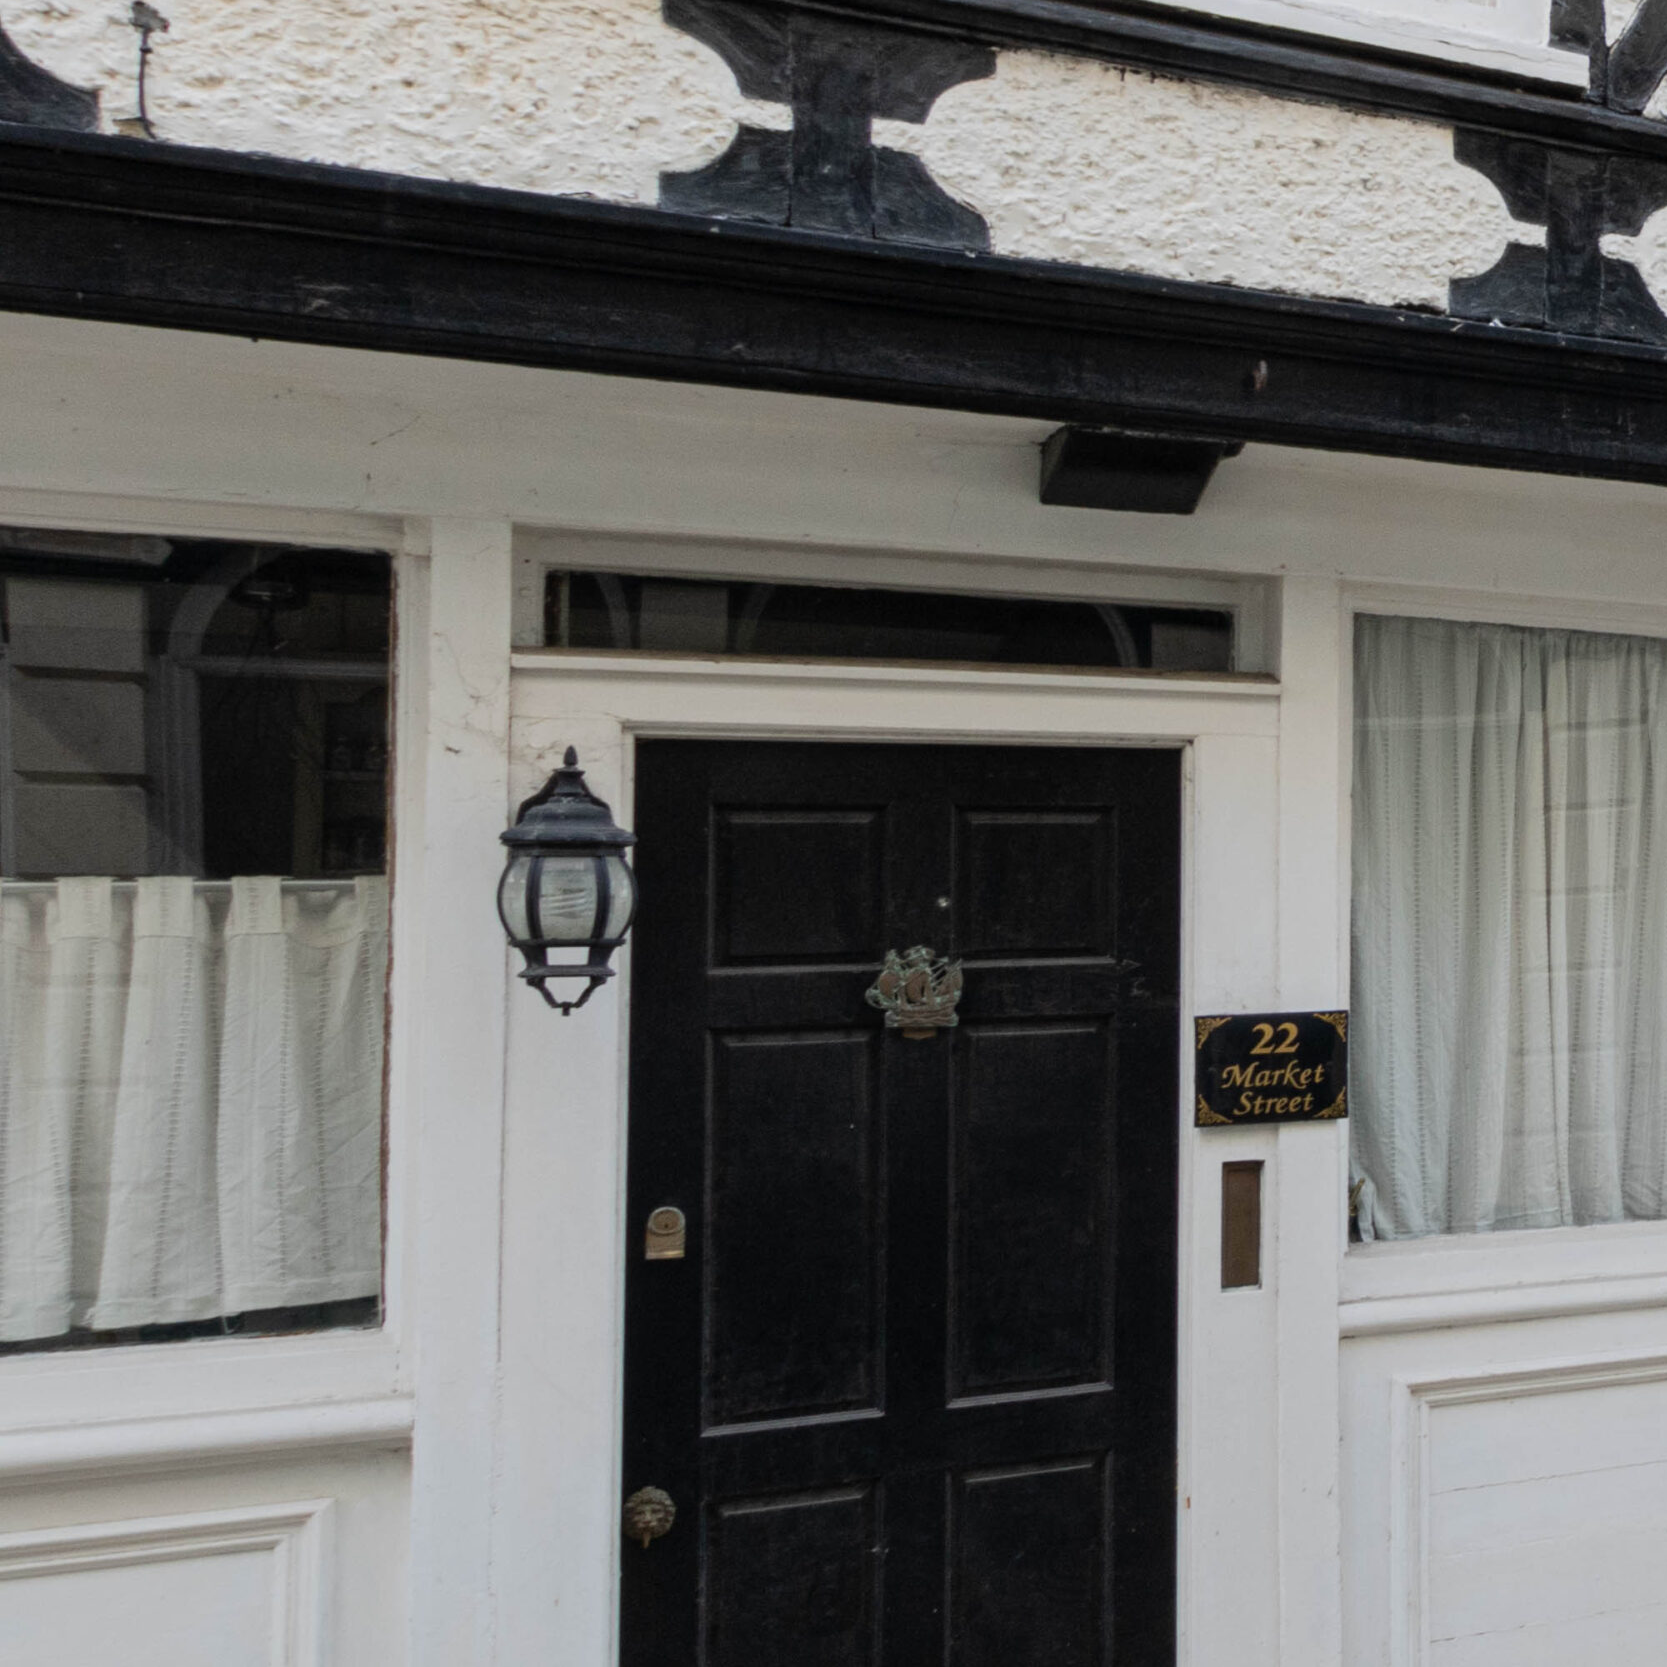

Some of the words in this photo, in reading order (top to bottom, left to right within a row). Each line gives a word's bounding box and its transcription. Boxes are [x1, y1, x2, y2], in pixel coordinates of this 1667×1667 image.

[1250, 1022, 1300, 1055] 22
[1221, 1060, 1325, 1089] Market
[1233, 1091, 1314, 1115] Street
